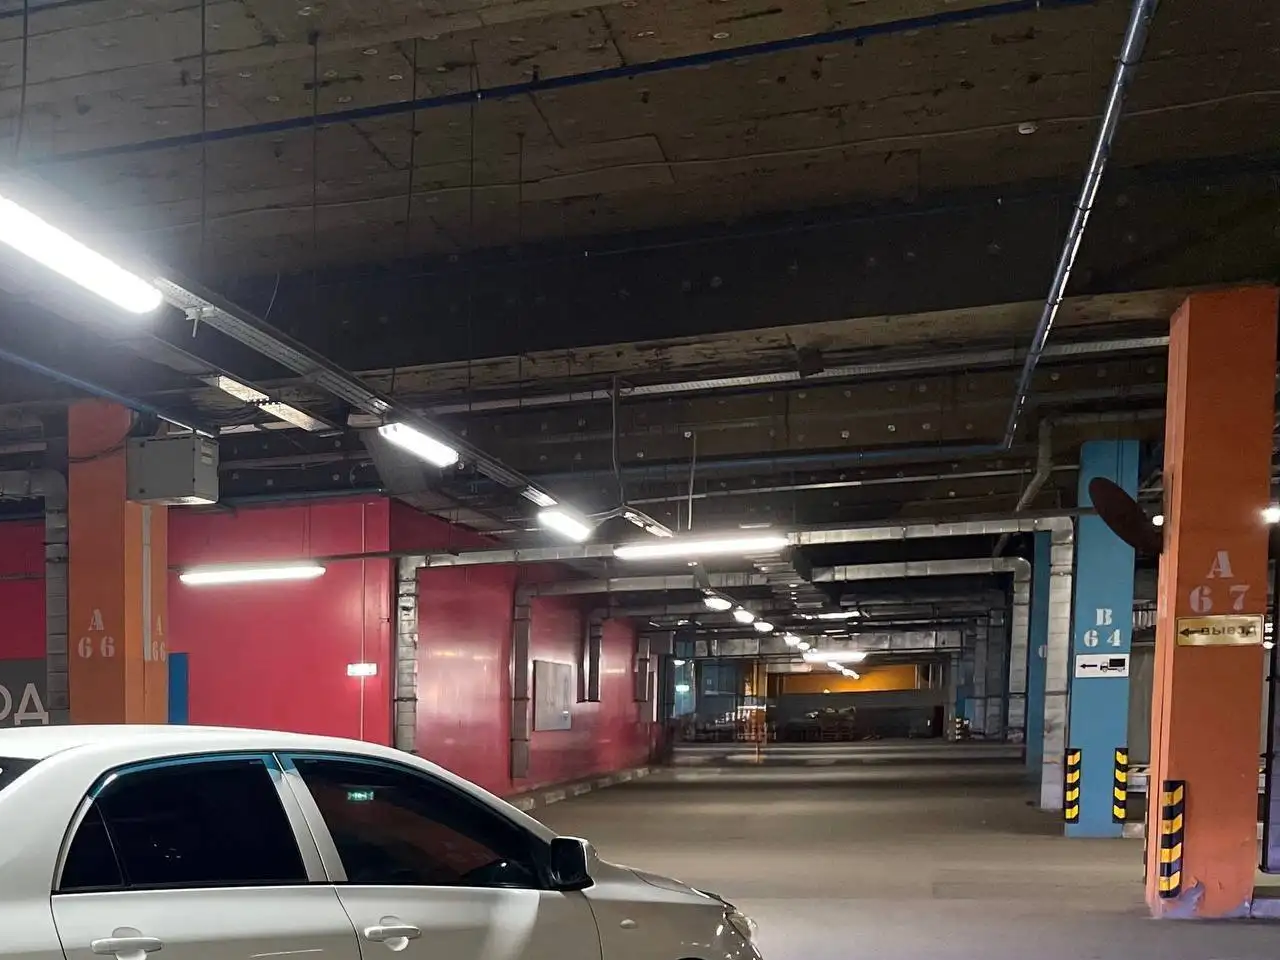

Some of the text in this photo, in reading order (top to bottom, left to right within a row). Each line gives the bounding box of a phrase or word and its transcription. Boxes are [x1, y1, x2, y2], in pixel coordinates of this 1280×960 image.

[1206, 550, 1234, 579] А
[1189, 584, 1250, 613] 67
[88, 608, 104, 631] А
[78, 635, 115, 659] 66
[1083, 629, 1121, 648] 64
